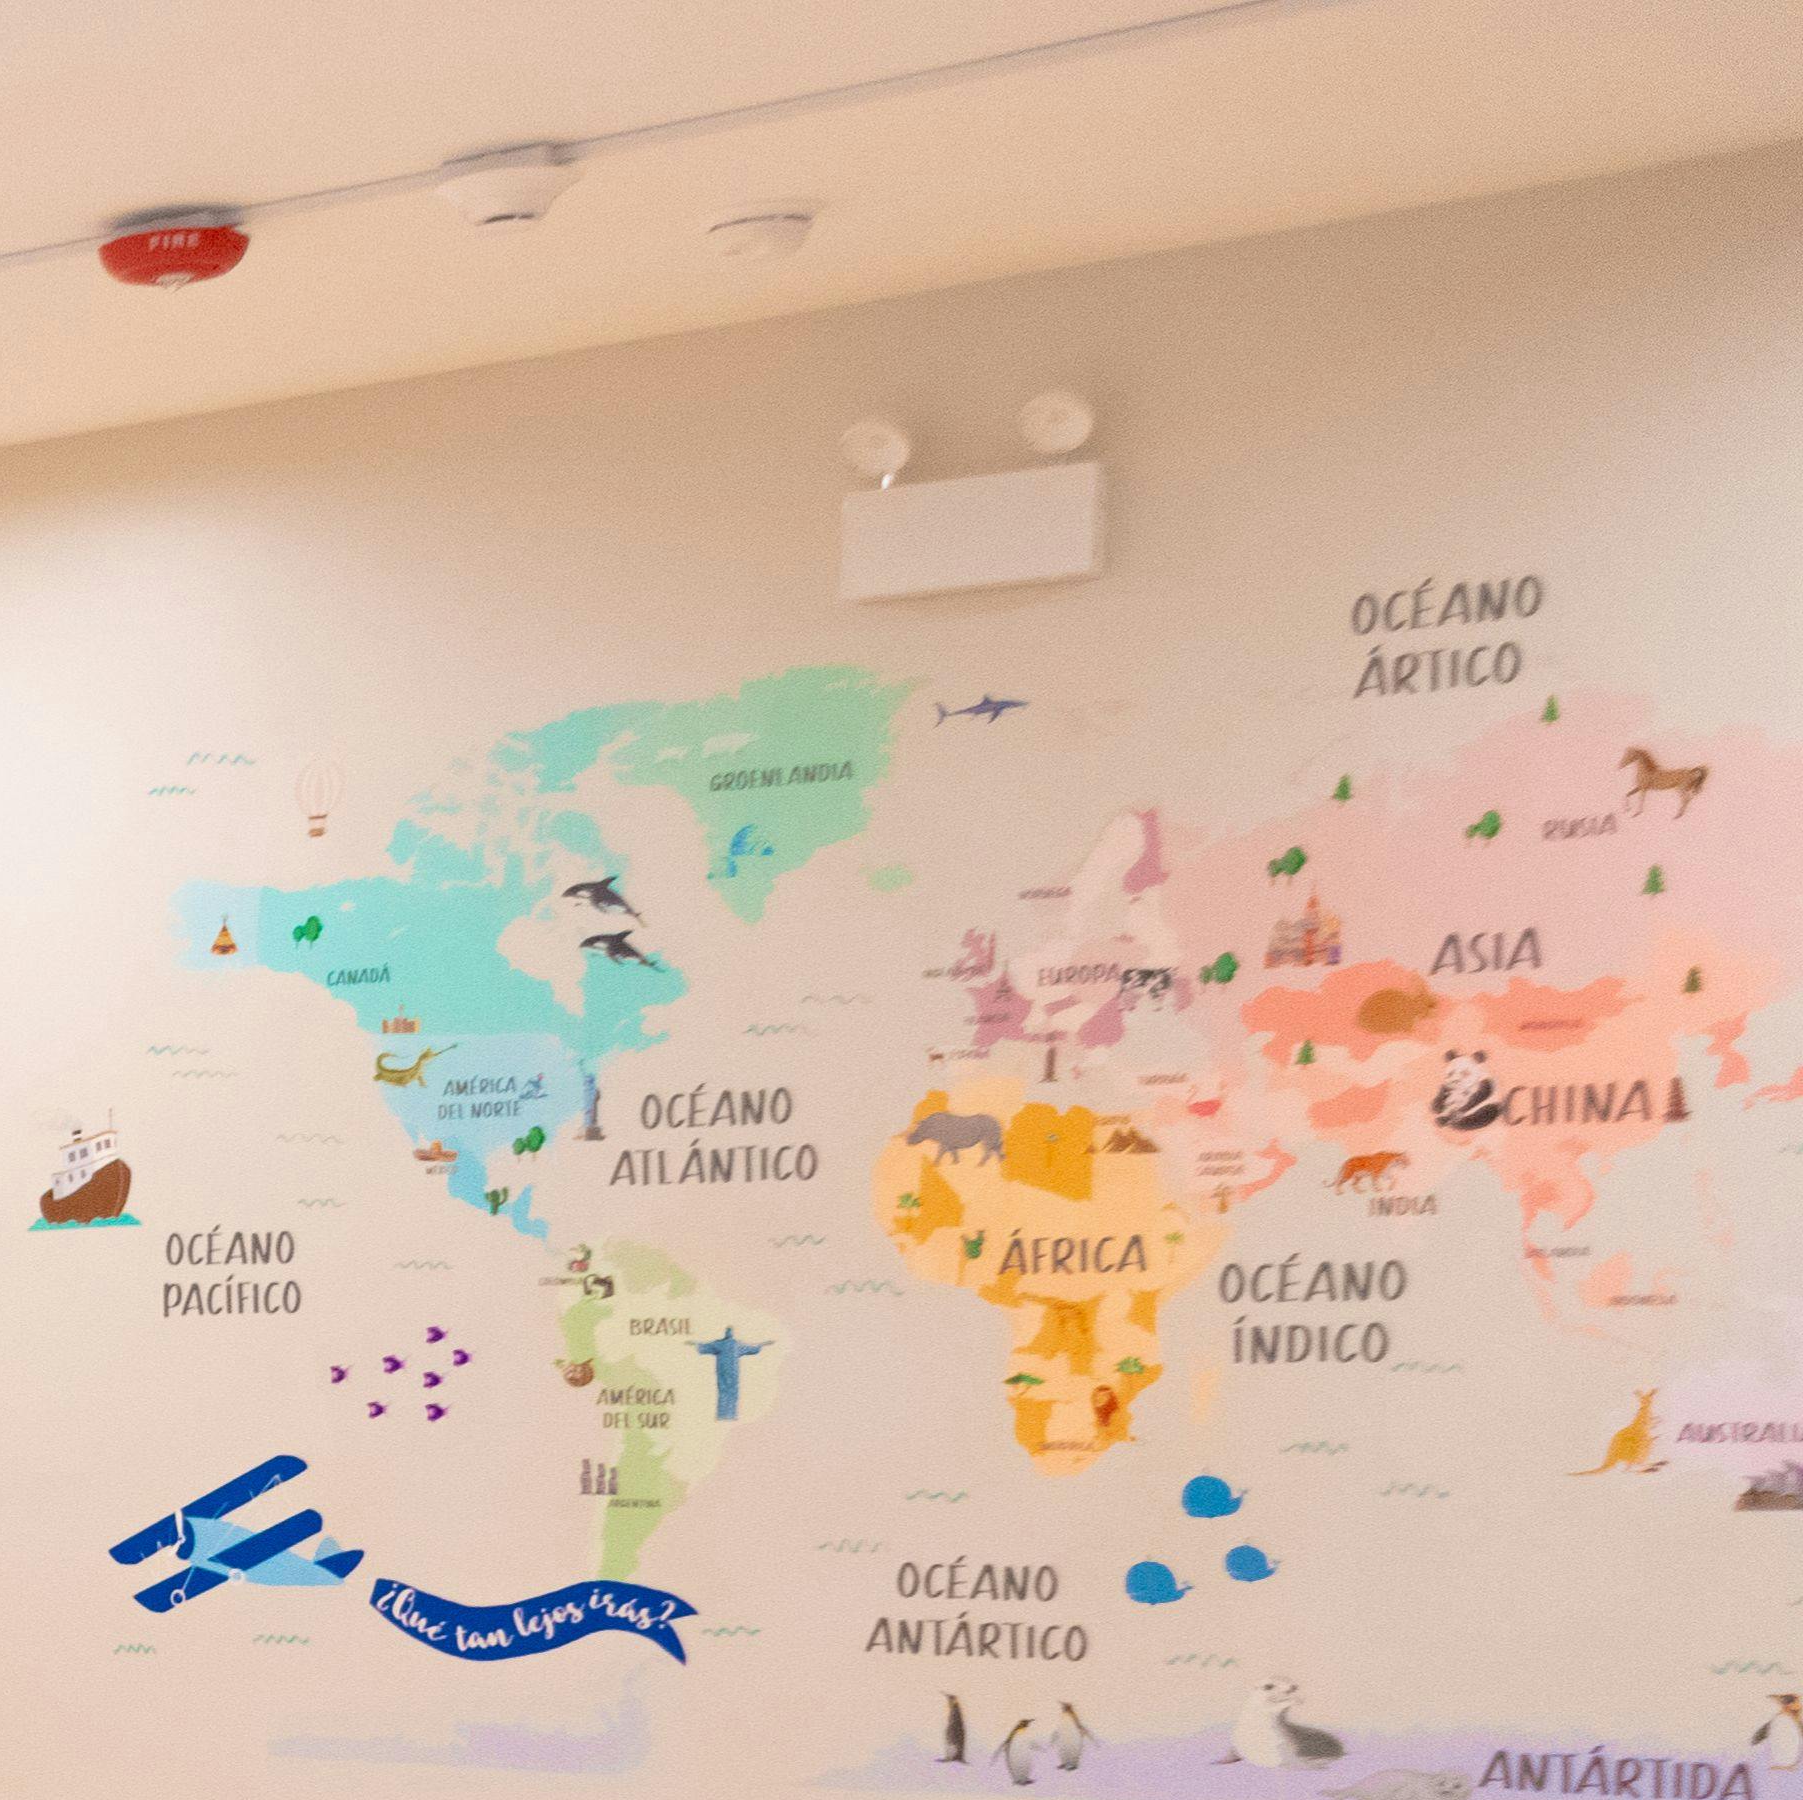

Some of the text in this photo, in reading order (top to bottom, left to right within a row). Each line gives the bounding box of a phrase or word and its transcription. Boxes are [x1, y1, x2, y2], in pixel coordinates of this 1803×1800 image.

[149, 233, 199, 250] FIRE
[1351, 575, 1543, 635] OCÉANO
[1354, 642, 1522, 699] ÁRTICO
[709, 761, 854, 791] GROENLANDIA
[1430, 928, 1543, 976] ASIA
[326, 963, 391, 986] CANADÁ
[1036, 963, 1121, 987] EUROPA
[443, 1075, 517, 1097] AMÉRICA
[641, 1083, 792, 1129] OCÉANO
[1501, 1080, 1652, 1126] CHINA
[437, 1100, 521, 1120] DEL NORTE
[610, 1138, 818, 1186] ATLÁNTICO
[1368, 1194, 1438, 1217] INDIA
[166, 1224, 294, 1265] OCÉANO
[998, 1229, 1147, 1275] ÁFRICA
[163, 1274, 301, 1317] PACÍFICO
[1219, 1252, 1407, 1303] OCÉANO
[629, 1317, 691, 1336] BRASIL
[1233, 1314, 1390, 1364] ÍNDICO
[596, 1385, 675, 1405] AMÉRICA
[602, 1411, 671, 1429] DEL SUR
[897, 1555, 1059, 1602] OCÉANO
[376, 1583, 676, 1651] ¿Qué tan lejos irás?
[865, 1611, 1088, 1662] ANTÁRTICO
